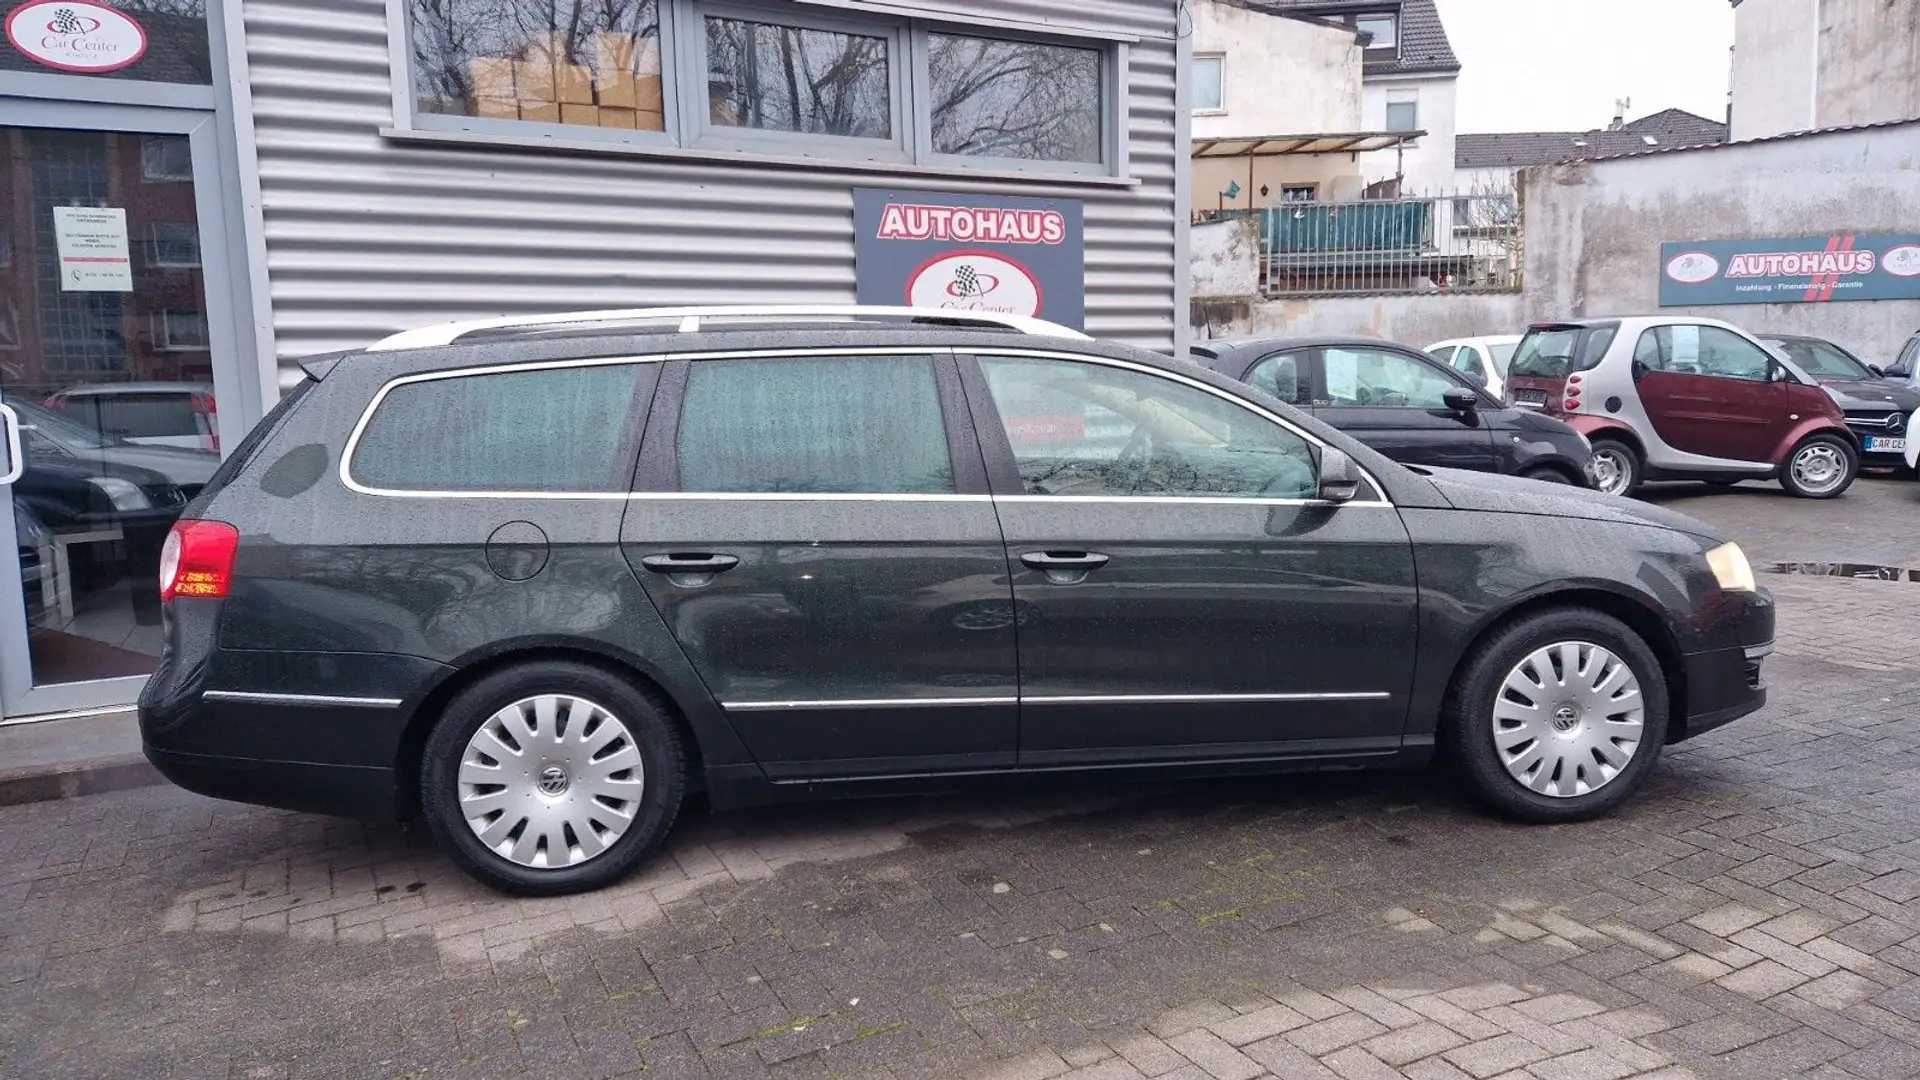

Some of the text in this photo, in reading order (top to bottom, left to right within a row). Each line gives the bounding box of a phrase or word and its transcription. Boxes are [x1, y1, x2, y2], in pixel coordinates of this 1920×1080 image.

[41, 35, 119, 52] Car Center
[879, 205, 1063, 243] AUTOHAUS
[1727, 251, 1873, 276] AUTOHAUS
[1735, 281, 1863, 292] Inzahlung Finanzierung Garantie
[1872, 439, 1890, 448] CAR
